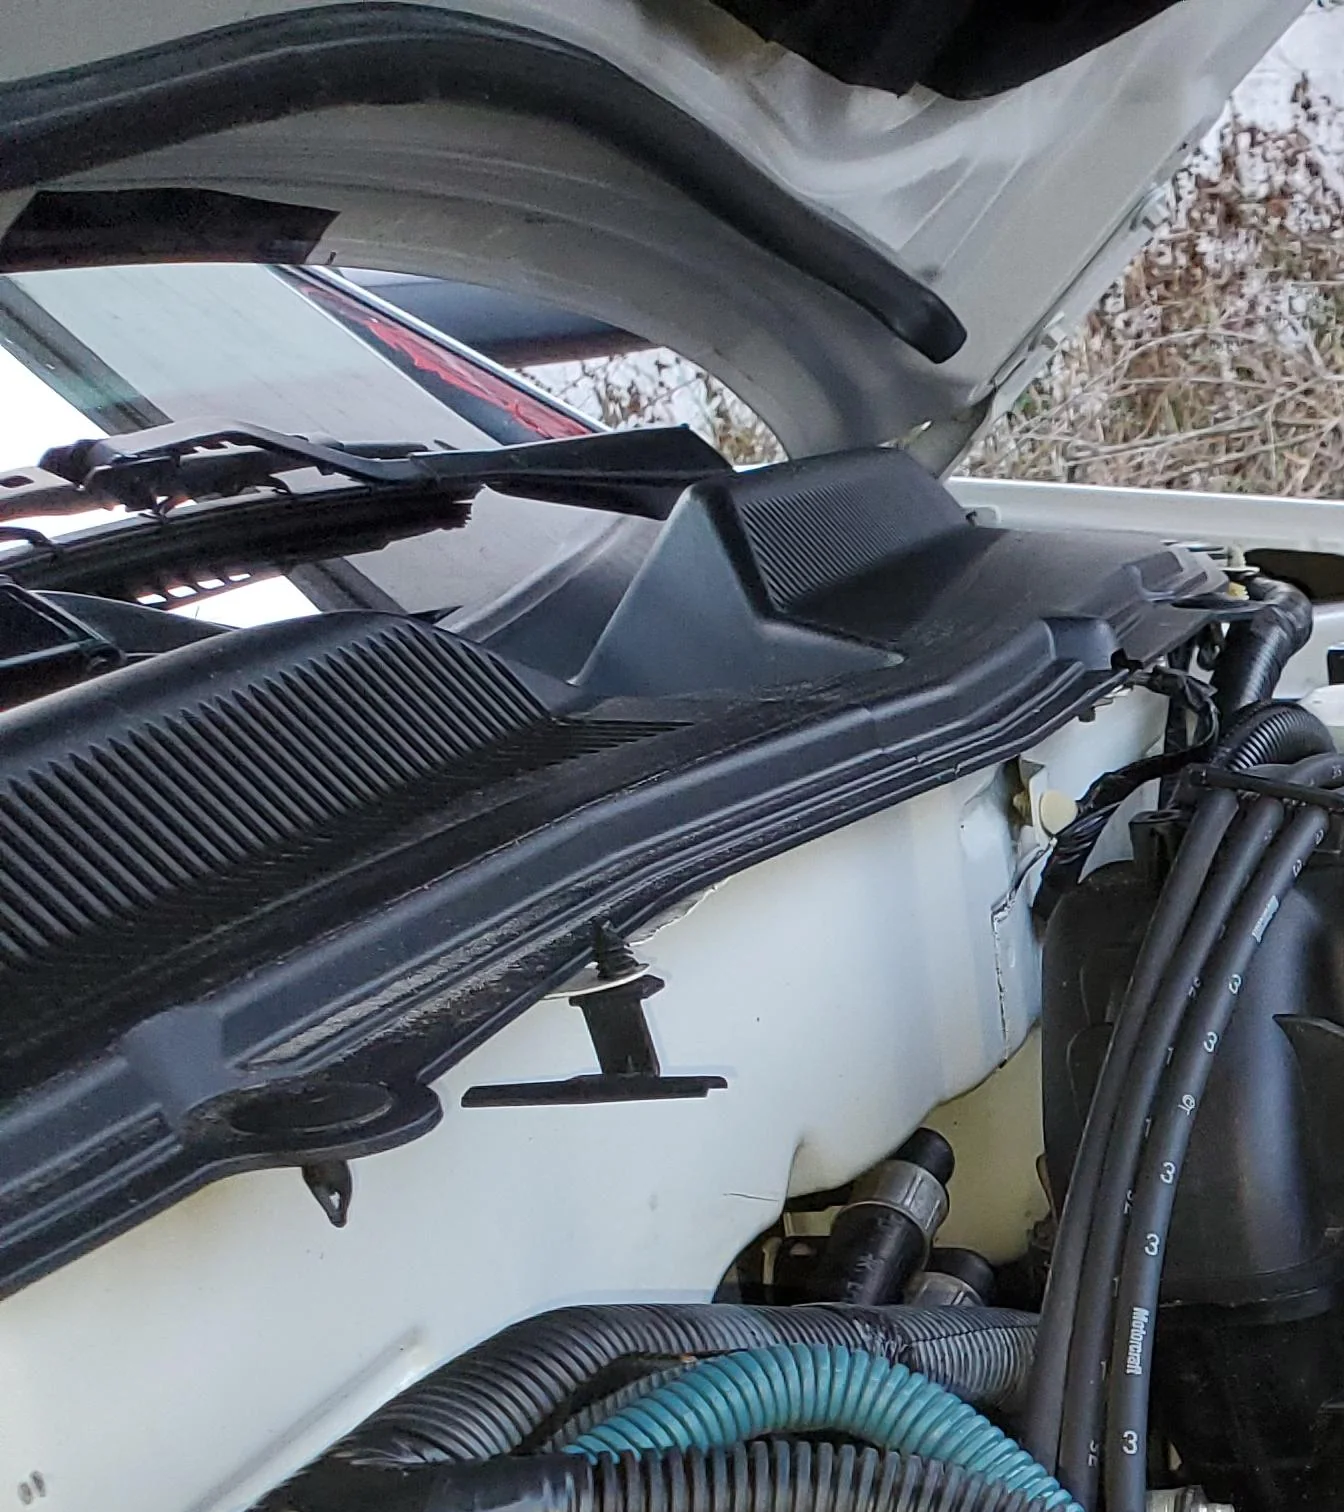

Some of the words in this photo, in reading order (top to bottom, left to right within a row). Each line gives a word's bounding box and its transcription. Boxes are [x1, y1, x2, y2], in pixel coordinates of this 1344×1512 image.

[1203, 1031, 1218, 1053] 3
[1160, 1161, 1176, 1184] 3
[1144, 1233, 1160, 1256] 3
[1125, 1306, 1151, 1376] Motorcraft
[1122, 1430, 1139, 1455] 3
